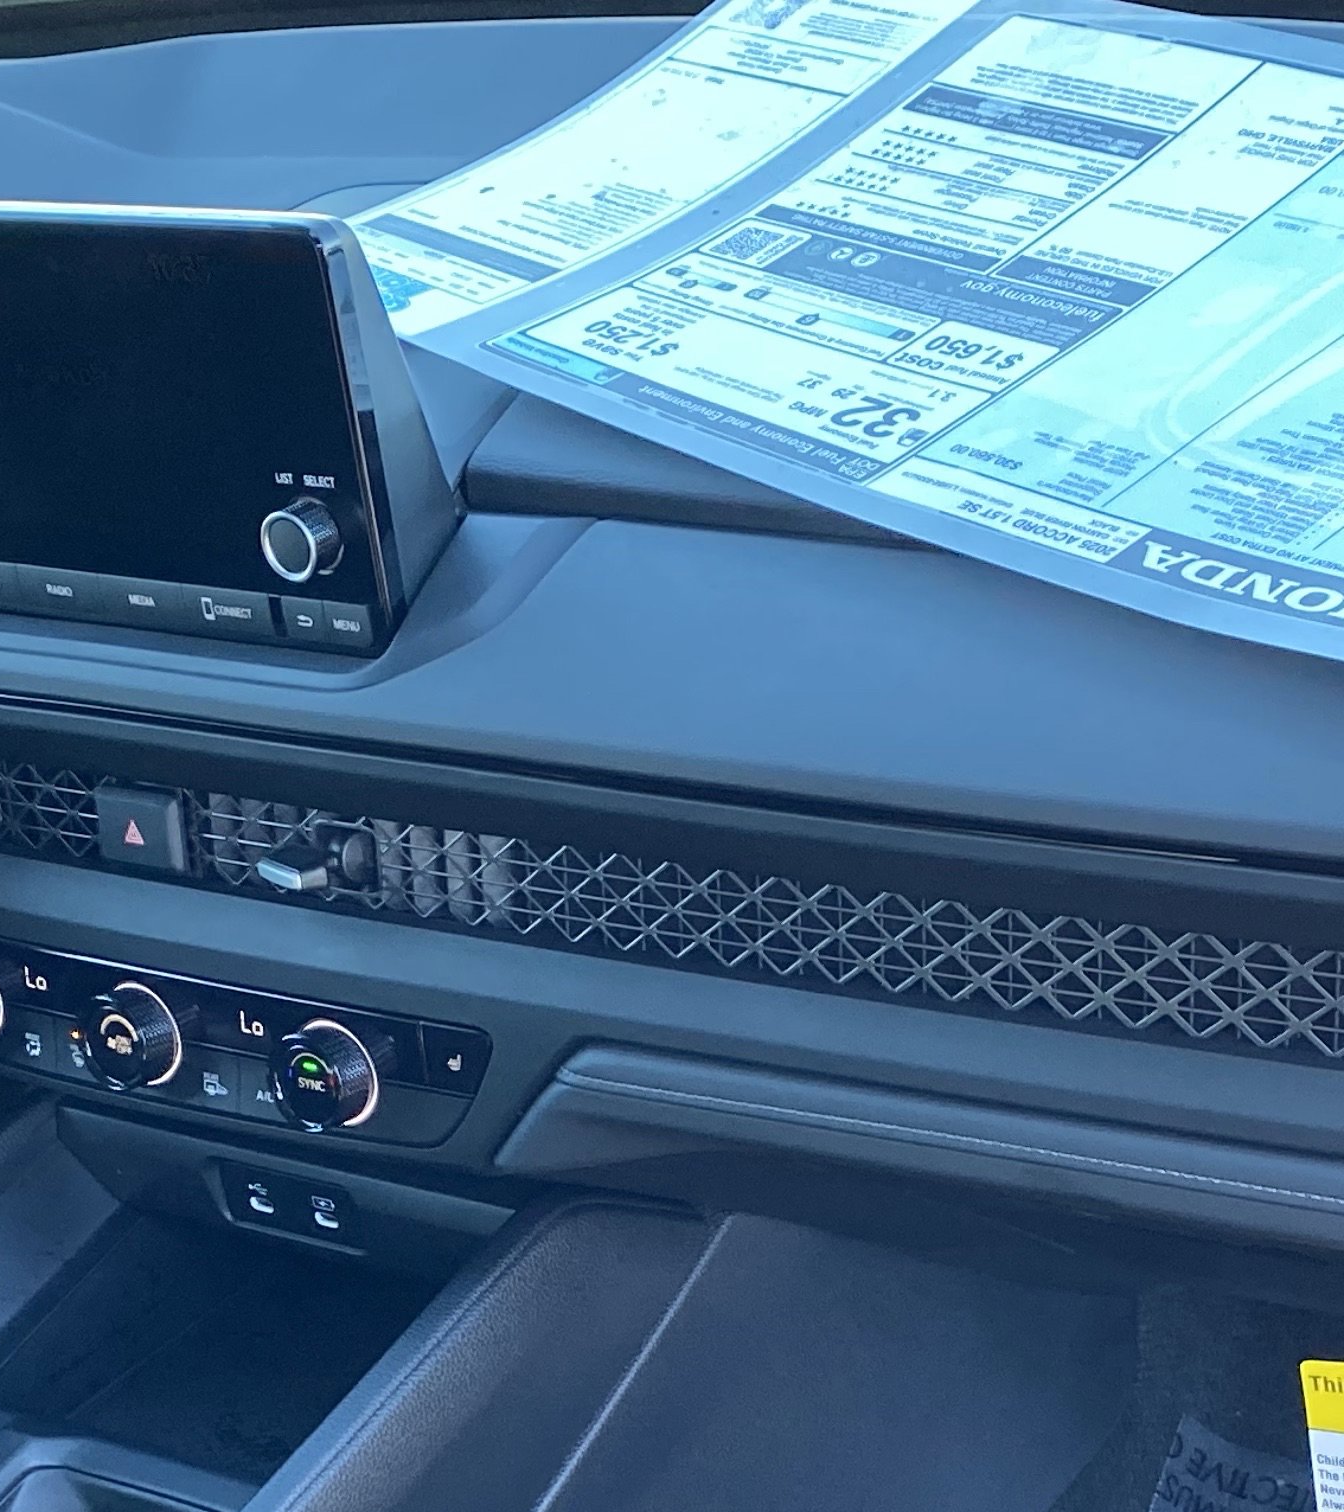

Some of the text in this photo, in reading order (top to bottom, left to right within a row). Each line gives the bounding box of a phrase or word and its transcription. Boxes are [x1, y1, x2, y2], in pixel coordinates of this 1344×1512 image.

[1041, 265, 1117, 288] INFORMATION
[956, 276, 1108, 323] fueleconomy.gov
[577, 318, 684, 358] $1,250
[577, 337, 626, 356] save
[890, 351, 947, 373] cost
[919, 331, 1030, 372] $1,650
[794, 376, 859, 400] 29 37
[630, 383, 881, 471] DOT Fuel Economy and Environment
[785, 394, 926, 441] 32 MPG
[946, 441, 1026, 471] $30,560.00
[274, 472, 335, 490] LIST SELECT
[834, 464, 868, 478] EPA
[954, 499, 1118, 556] 2025 ACCORD 1.5T SE
[45, 584, 73, 597] RADIO
[128, 594, 155, 607] MEDIA
[214, 605, 252, 619] CONNECT
[333, 618, 361, 632] MENU
[297, 1077, 326, 1092] SYNC
[1319, 1469, 1339, 1481] The
